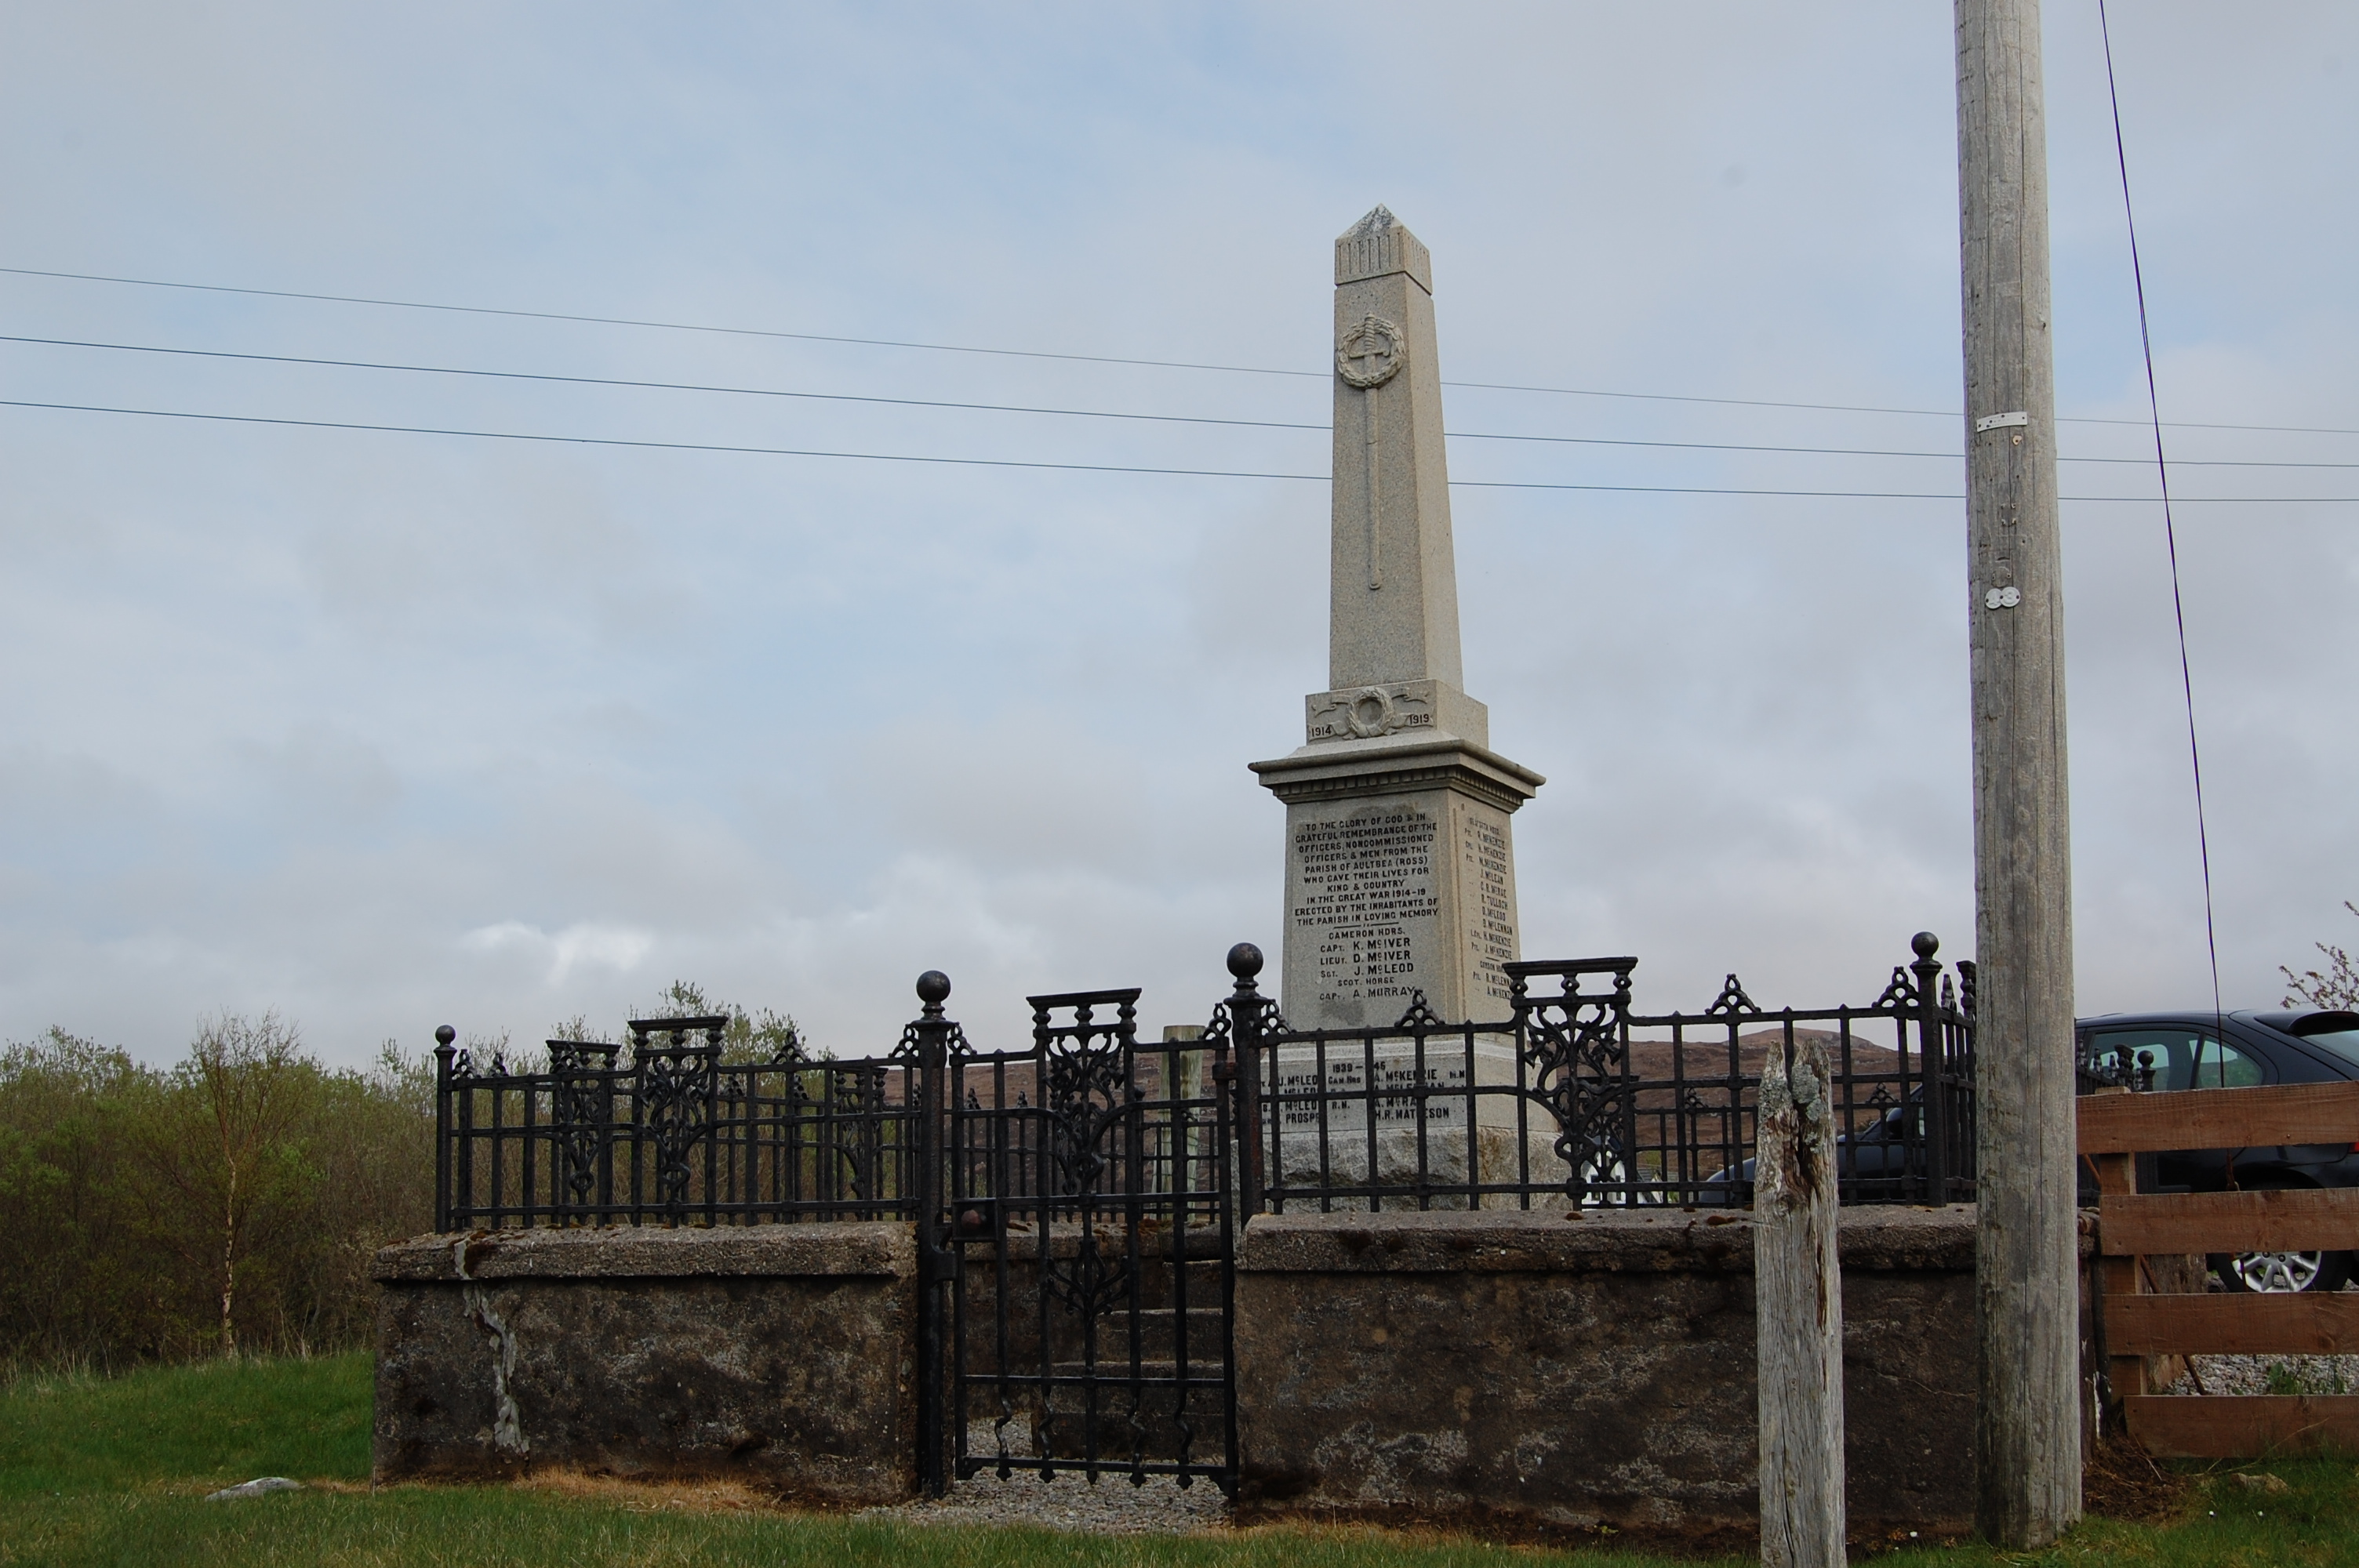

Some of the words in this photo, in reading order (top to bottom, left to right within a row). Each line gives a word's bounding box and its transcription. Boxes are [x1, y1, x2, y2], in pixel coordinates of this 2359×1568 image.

[1409, 714, 1430, 724] 1919
[1311, 726, 1332, 736] 1914
[1339, 819, 1367, 829] GLORY
[1371, 817, 1382, 826] OF
[1385, 815, 1403, 823] GOD
[1296, 831, 1338, 843] GRATEFUL
[1340, 826, 1406, 839] REMEMBRANCE
[1408, 824, 1419, 833] OF
[1422, 822, 1437, 831] THE
[1346, 834, 1434, 849] NONCOMMISSIONED
[1304, 853, 1347, 863] OFFICERS
[1360, 850, 1379, 858] MEN
[1383, 847, 1408, 856] FROM
[1411, 845, 1428, 854] THE
[1305, 864, 1336, 874] PARISH
[1354, 858, 1393, 869] AULTBEA
[1395, 855, 1428, 867] (ROSS)
[1303, 876, 1324, 884] WHO
[1327, 873, 1350, 883] GAVE
[1354, 871, 1379, 880] THEIR
[1382, 869, 1408, 878] LIVES
[1412, 867, 1430, 876] FOR
[1327, 884, 1349, 893] KING
[1364, 879, 1405, 890] COUNTRY
[1318, 895, 1335, 904] THE
[1338, 893, 1366, 902] GREAT
[1369, 891, 1390, 900] WAR
[1295, 906, 1332, 916] ERECTED
[1336, 905, 1348, 913] BY
[1350, 903, 1367, 912] THE
[1369, 898, 1423, 910] INHABITANTS
[1296, 917, 1314, 927] THE
[1317, 914, 1349, 924] PARISH
[1351, 913, 1361, 922] IN
[1364, 911, 1396, 921] LOVING
[1399, 908, 1439, 918] MEMORY
[1329, 930, 1373, 940] CAMERON
[1353, 941, 1364, 951] K.
[1353, 953, 1364, 964] D.
[1354, 966, 1364, 976] J.
[1368, 986, 1415, 998] MURRAY
[1332, 1063, 1353, 1073] 1939
[1287, 1075, 1318, 1086] McLEO
